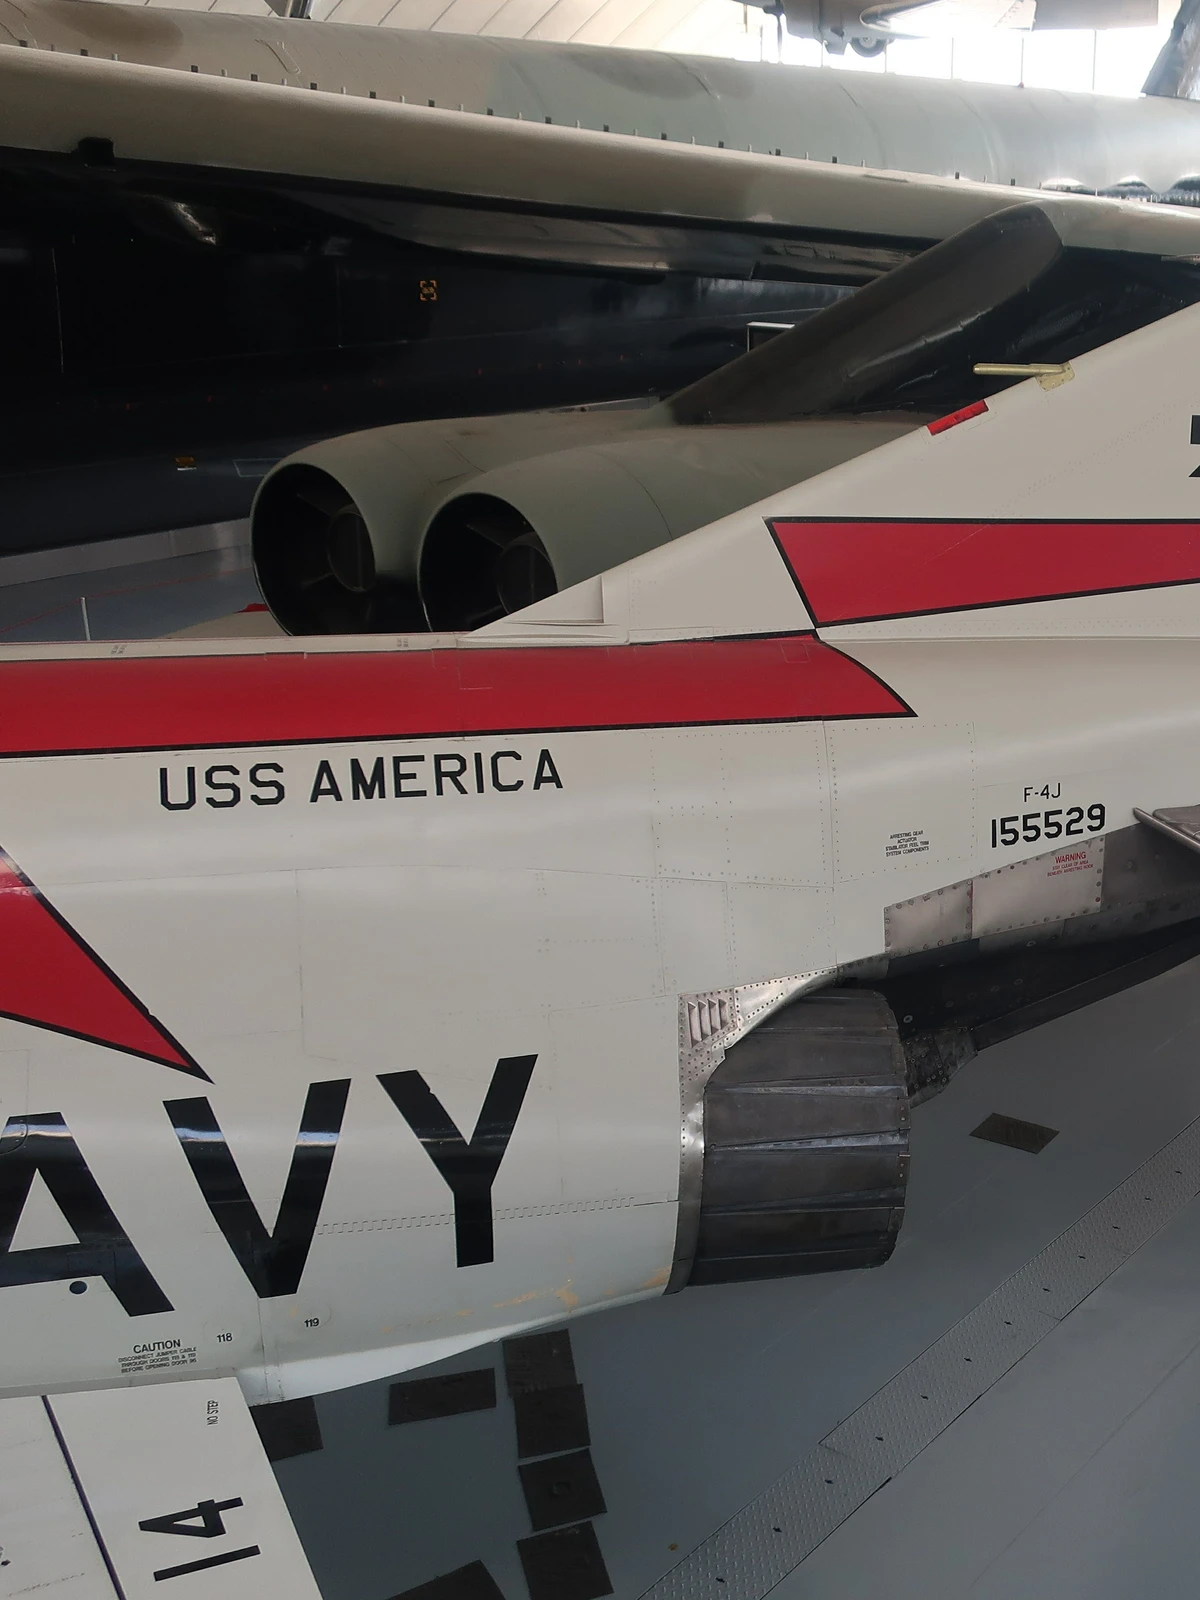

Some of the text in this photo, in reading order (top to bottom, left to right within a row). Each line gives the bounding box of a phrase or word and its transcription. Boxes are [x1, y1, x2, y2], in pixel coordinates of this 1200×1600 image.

[160, 749, 563, 811] USS AMERICA
[1024, 783, 1060, 802] F-4J
[992, 803, 1105, 848] 155529
[903, 846, 930, 854] COMPONENTS
[1055, 851, 1086, 863] WARNING
[304, 1318, 319, 1327] 119
[217, 1333, 232, 1342] 118
[133, 1339, 181, 1353] CAUTION
[118, 1354, 154, 1363] DISCONNECT
[156, 1350, 178, 1358] JUMPER
[121, 1360, 148, 1368] THROUGH
[150, 1356, 170, 1364] DOORS
[207, 1400, 219, 1426] NO STEP
[138, 1497, 260, 1582] 14
